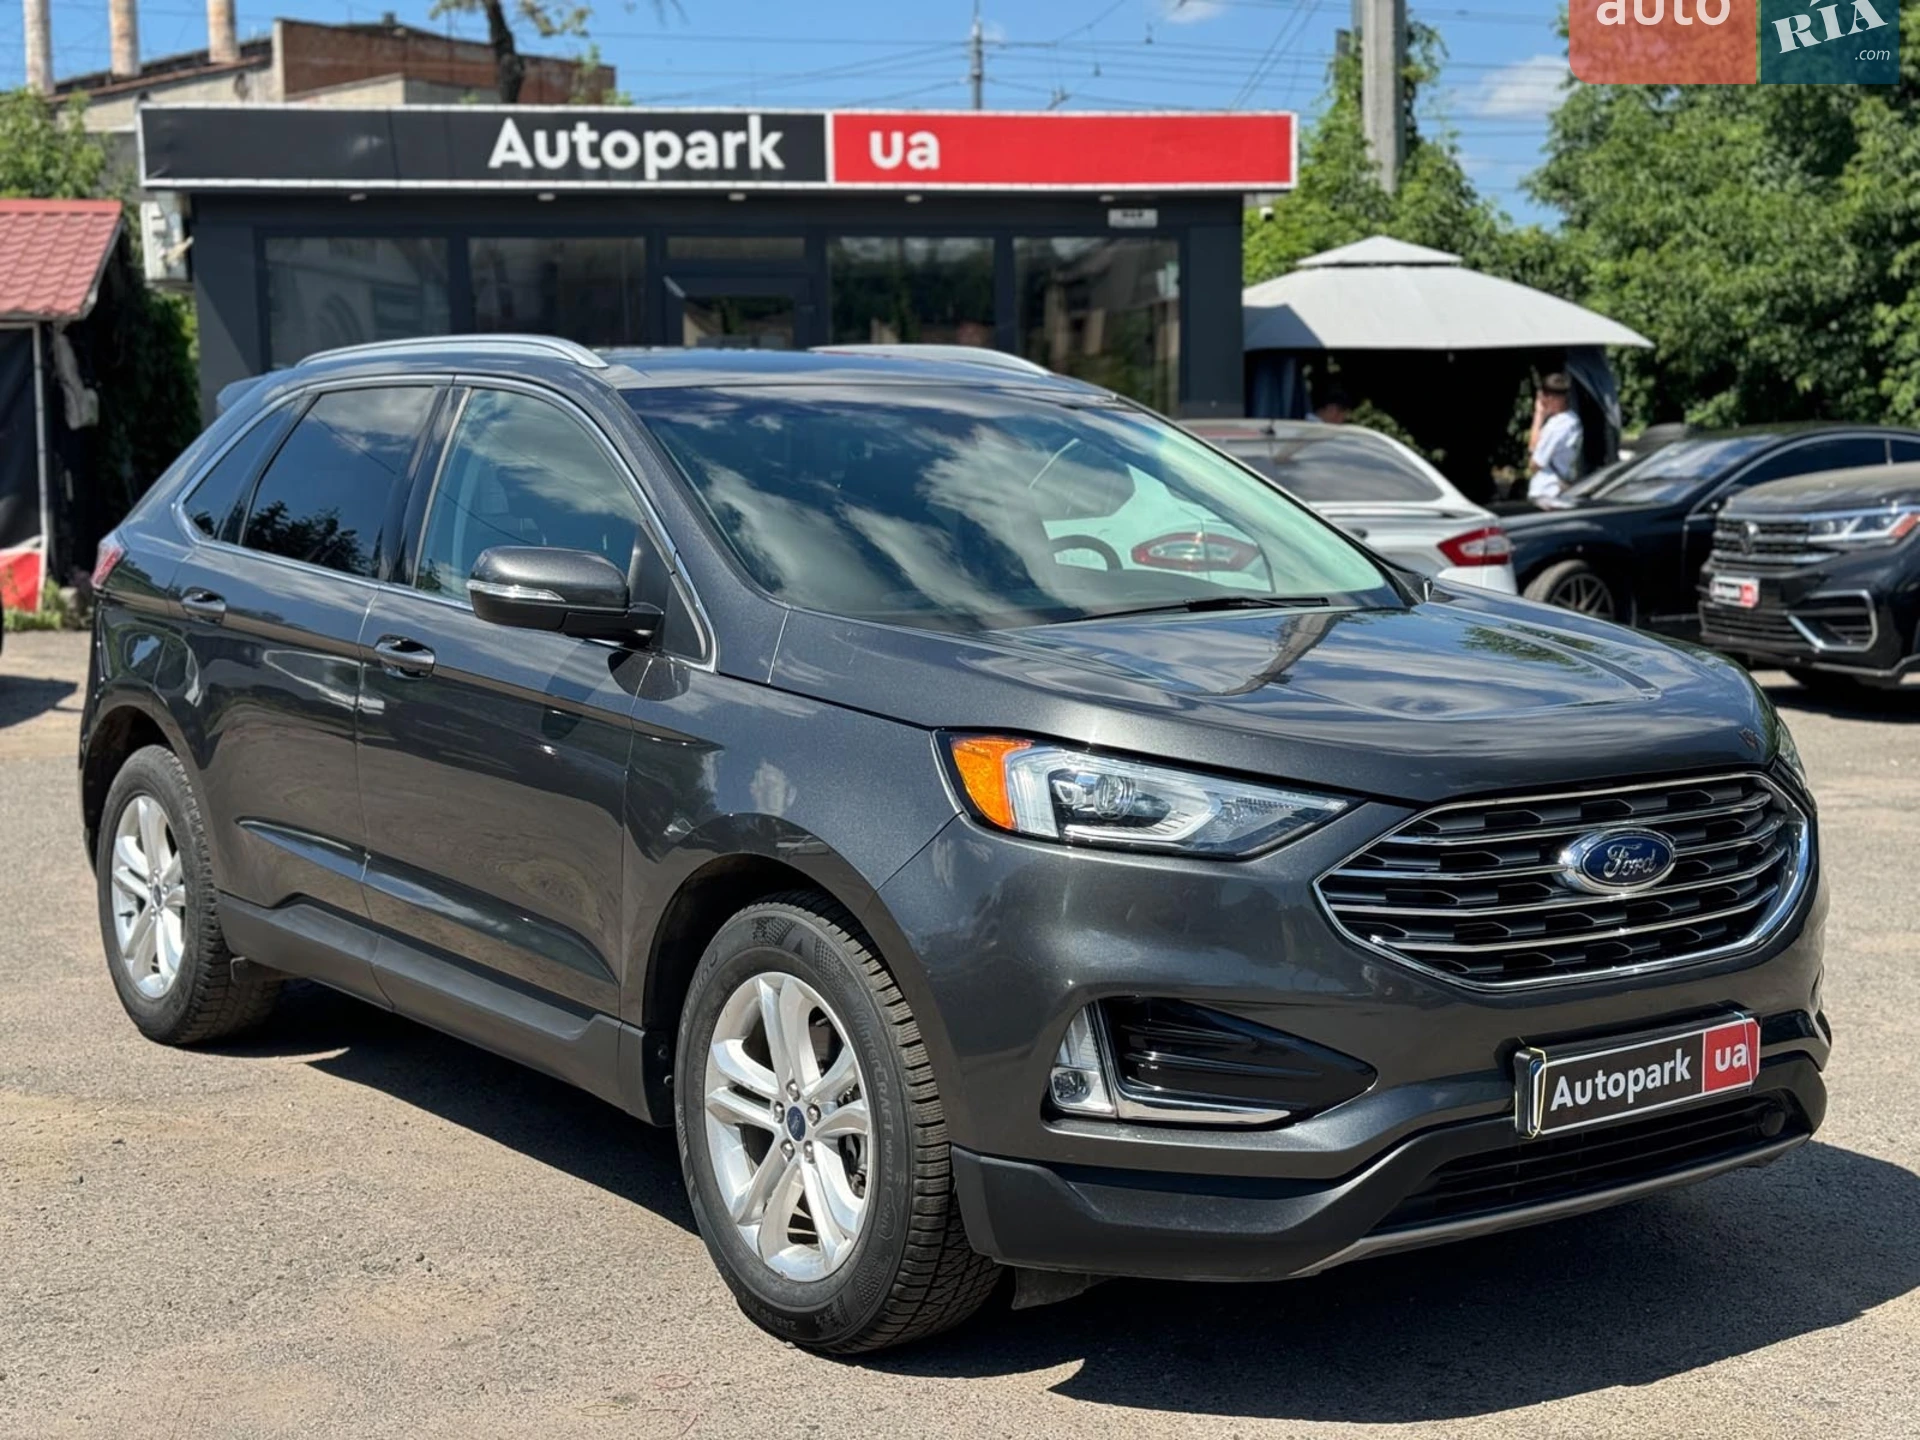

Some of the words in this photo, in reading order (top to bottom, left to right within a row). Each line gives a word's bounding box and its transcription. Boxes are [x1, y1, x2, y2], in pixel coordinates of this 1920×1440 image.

[487, 114, 785, 181] Autopark
[868, 130, 941, 170] ua
[1602, 843, 1657, 878] Ford
[1550, 1048, 1692, 1112] Autopark
[1714, 1042, 1749, 1073] ua
